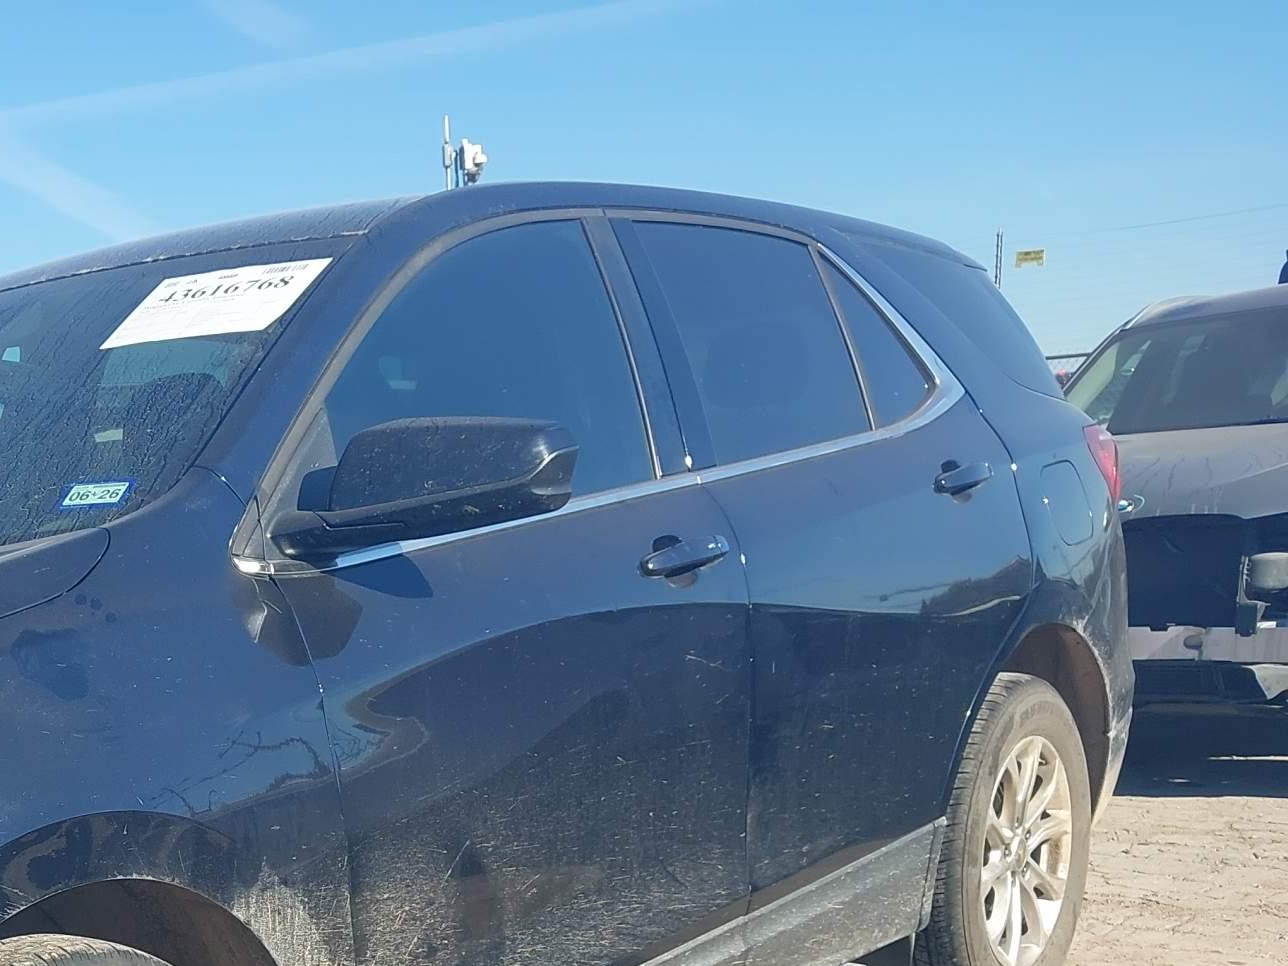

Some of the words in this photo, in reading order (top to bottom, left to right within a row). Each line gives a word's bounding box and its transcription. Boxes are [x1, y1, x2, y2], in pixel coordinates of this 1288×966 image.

[158, 275, 295, 303] 43616768
[69, 490, 91, 502] 06
[98, 488, 121, 500] 26
